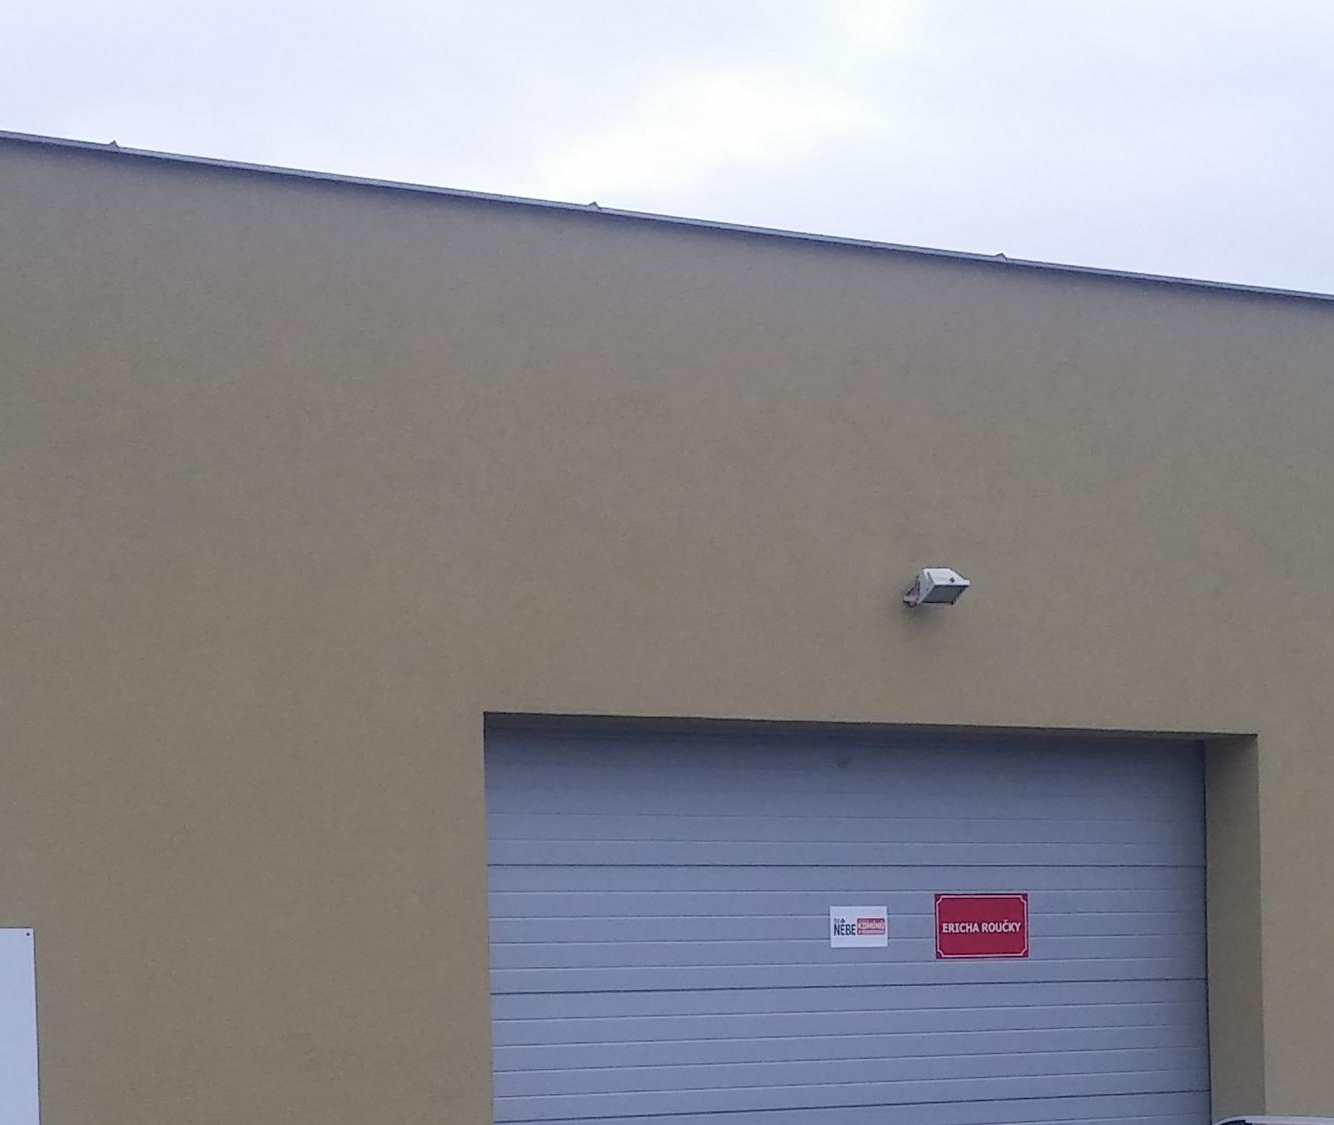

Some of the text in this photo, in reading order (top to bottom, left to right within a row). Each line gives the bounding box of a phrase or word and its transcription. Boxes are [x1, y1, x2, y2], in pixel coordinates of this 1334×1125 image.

[833, 923, 856, 937] NEBE
[942, 919, 1021, 934] ERICHA ROUČKY
